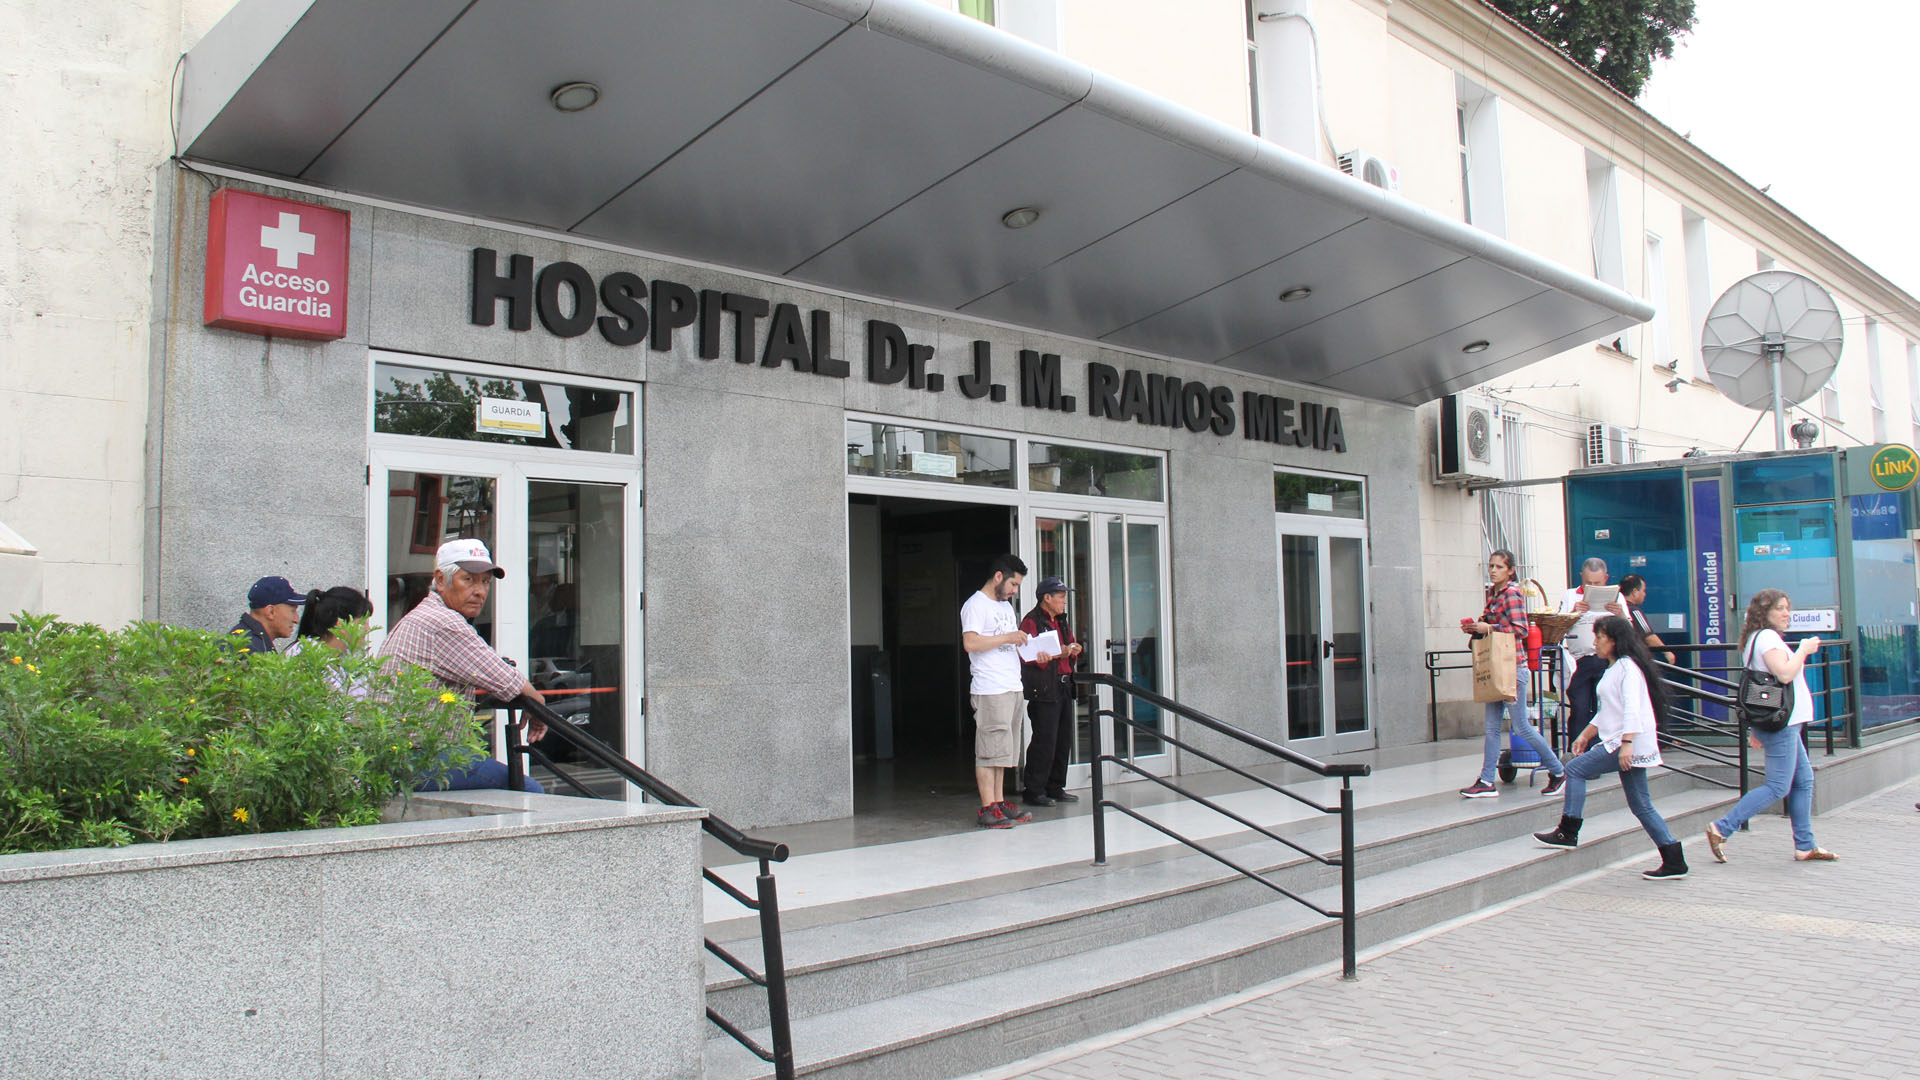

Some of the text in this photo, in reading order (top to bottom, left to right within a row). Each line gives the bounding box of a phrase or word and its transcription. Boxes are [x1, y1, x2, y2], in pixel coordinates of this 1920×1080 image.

[241, 263, 330, 294] Acceso
[239, 286, 331, 318] Guardia
[473, 247, 1346, 453] HOSPITAL Dr. J. M. RAMOS MEJIA
[491, 405, 531, 416] GUARDIA
[1702, 551, 1720, 636] Banco Ciudad
[1792, 613, 1820, 622] Ciudad
